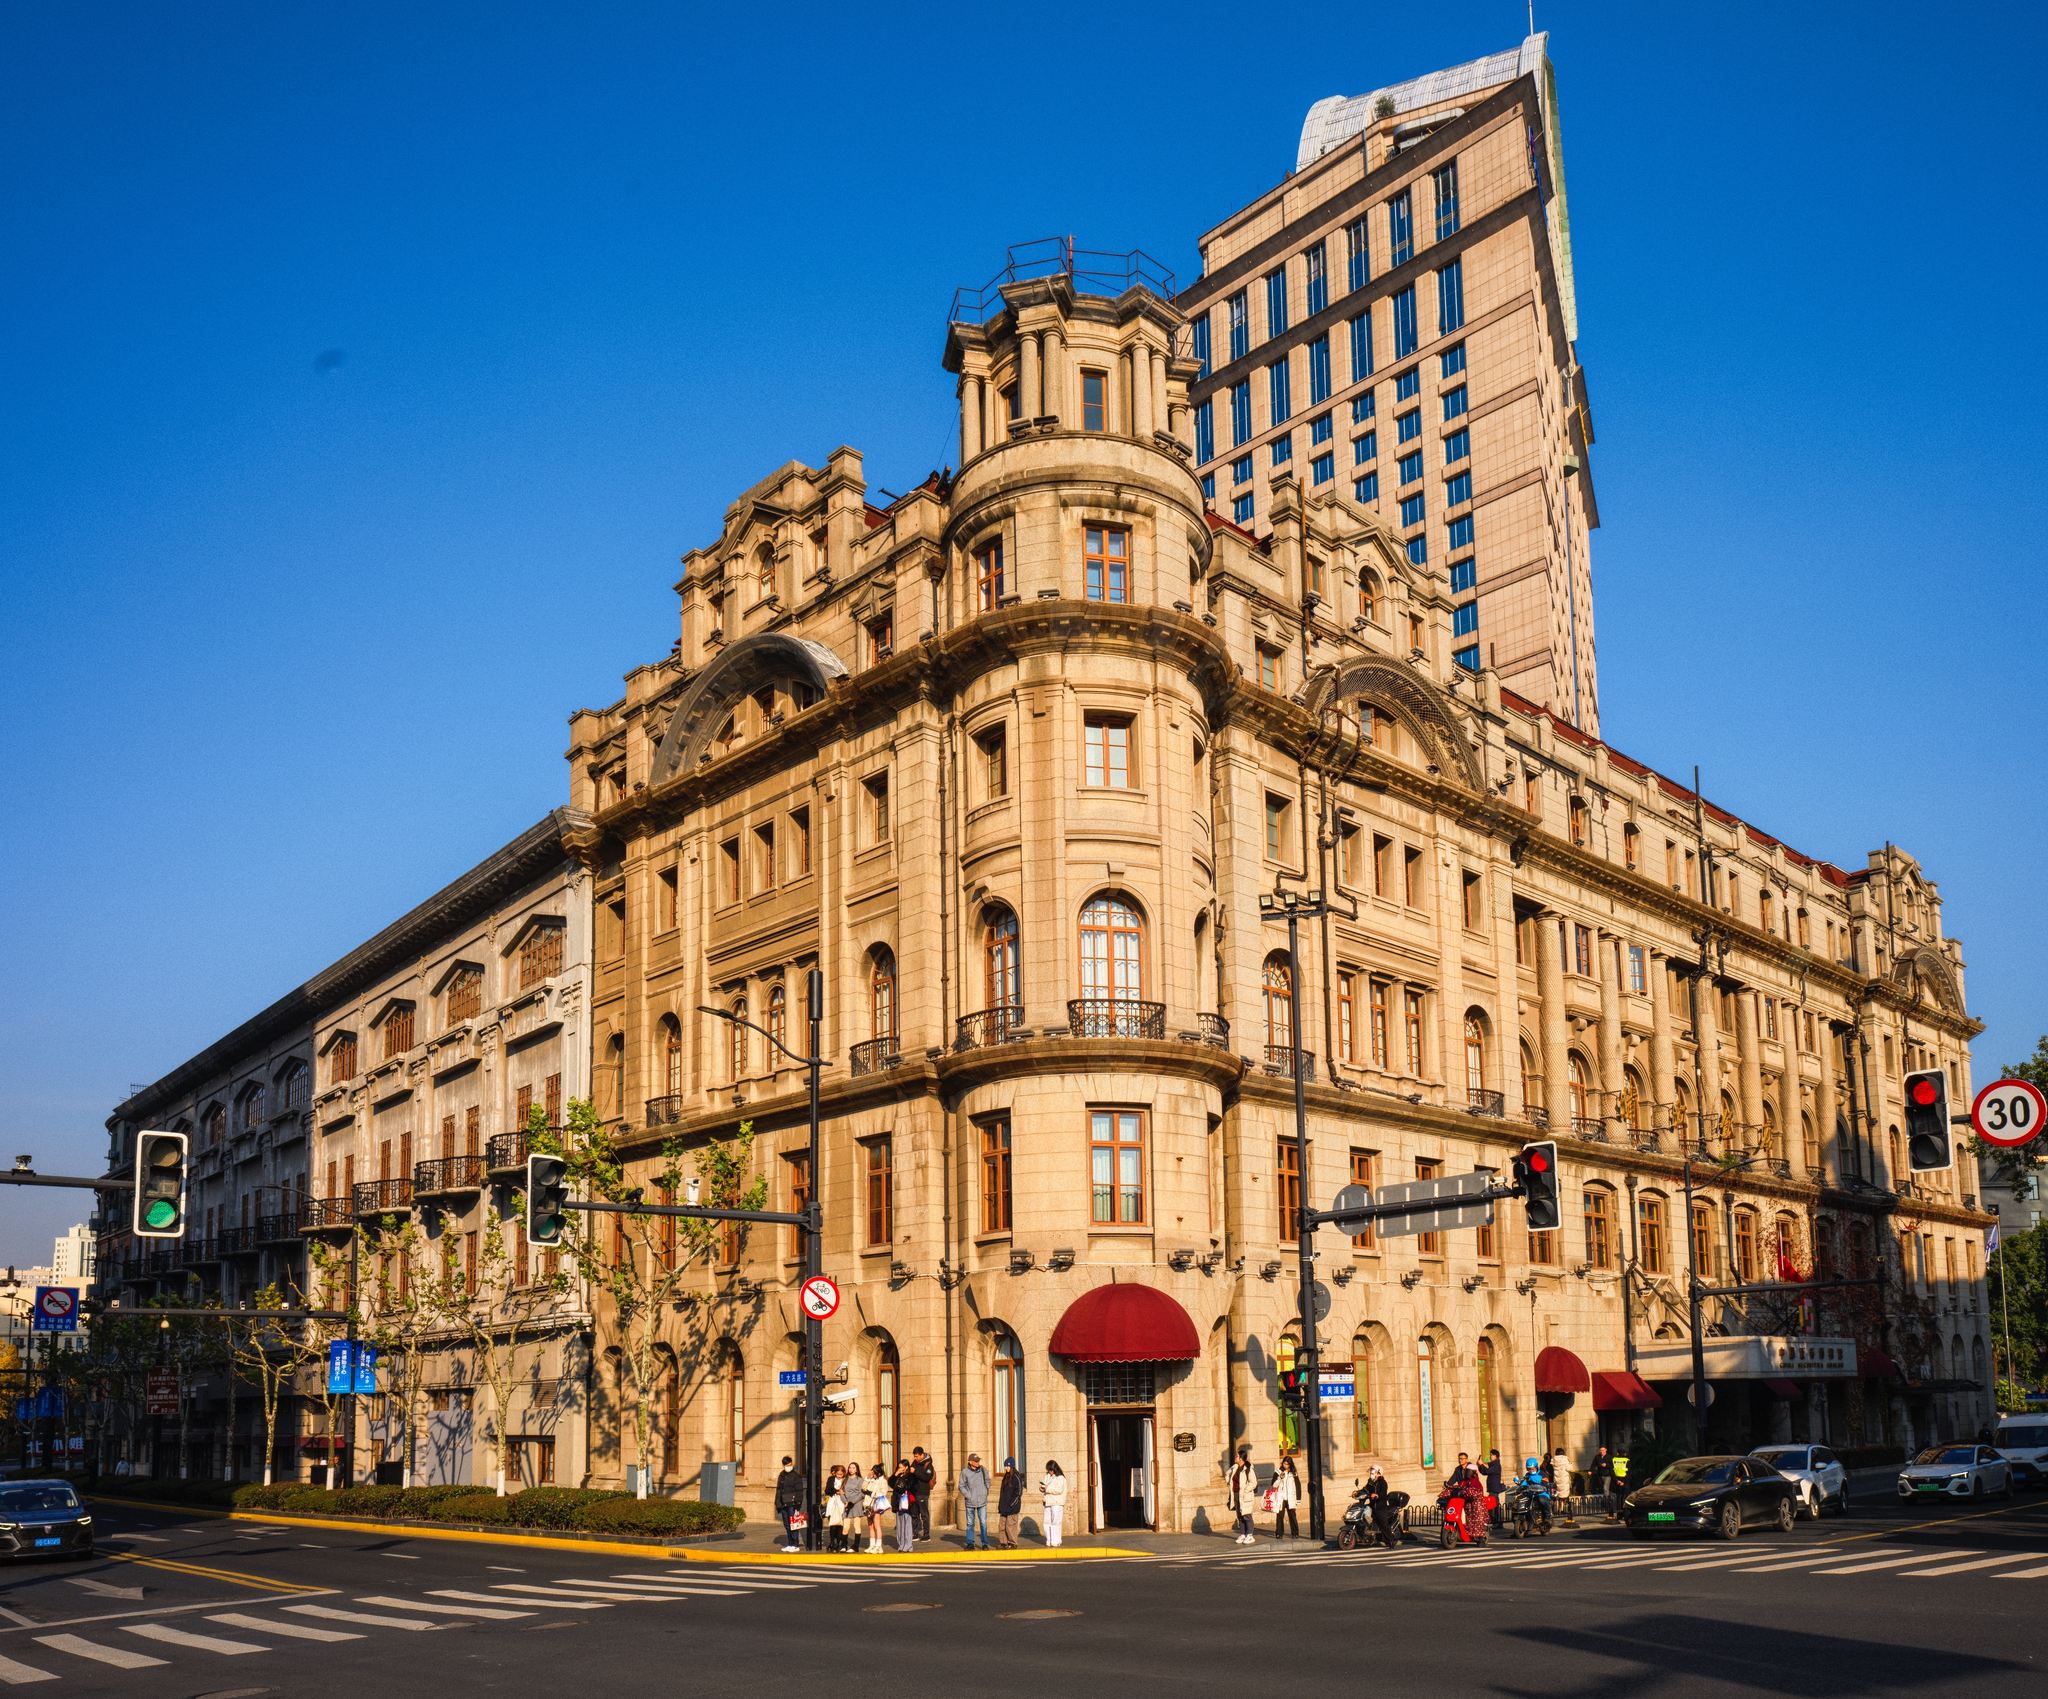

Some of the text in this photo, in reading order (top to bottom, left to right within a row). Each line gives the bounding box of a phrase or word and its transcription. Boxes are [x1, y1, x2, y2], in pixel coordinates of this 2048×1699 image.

[1986, 1095, 2030, 1130] 30
[786, 1374, 802, 1382] 大名路
[1327, 1386, 1346, 1395] 黄浦路
